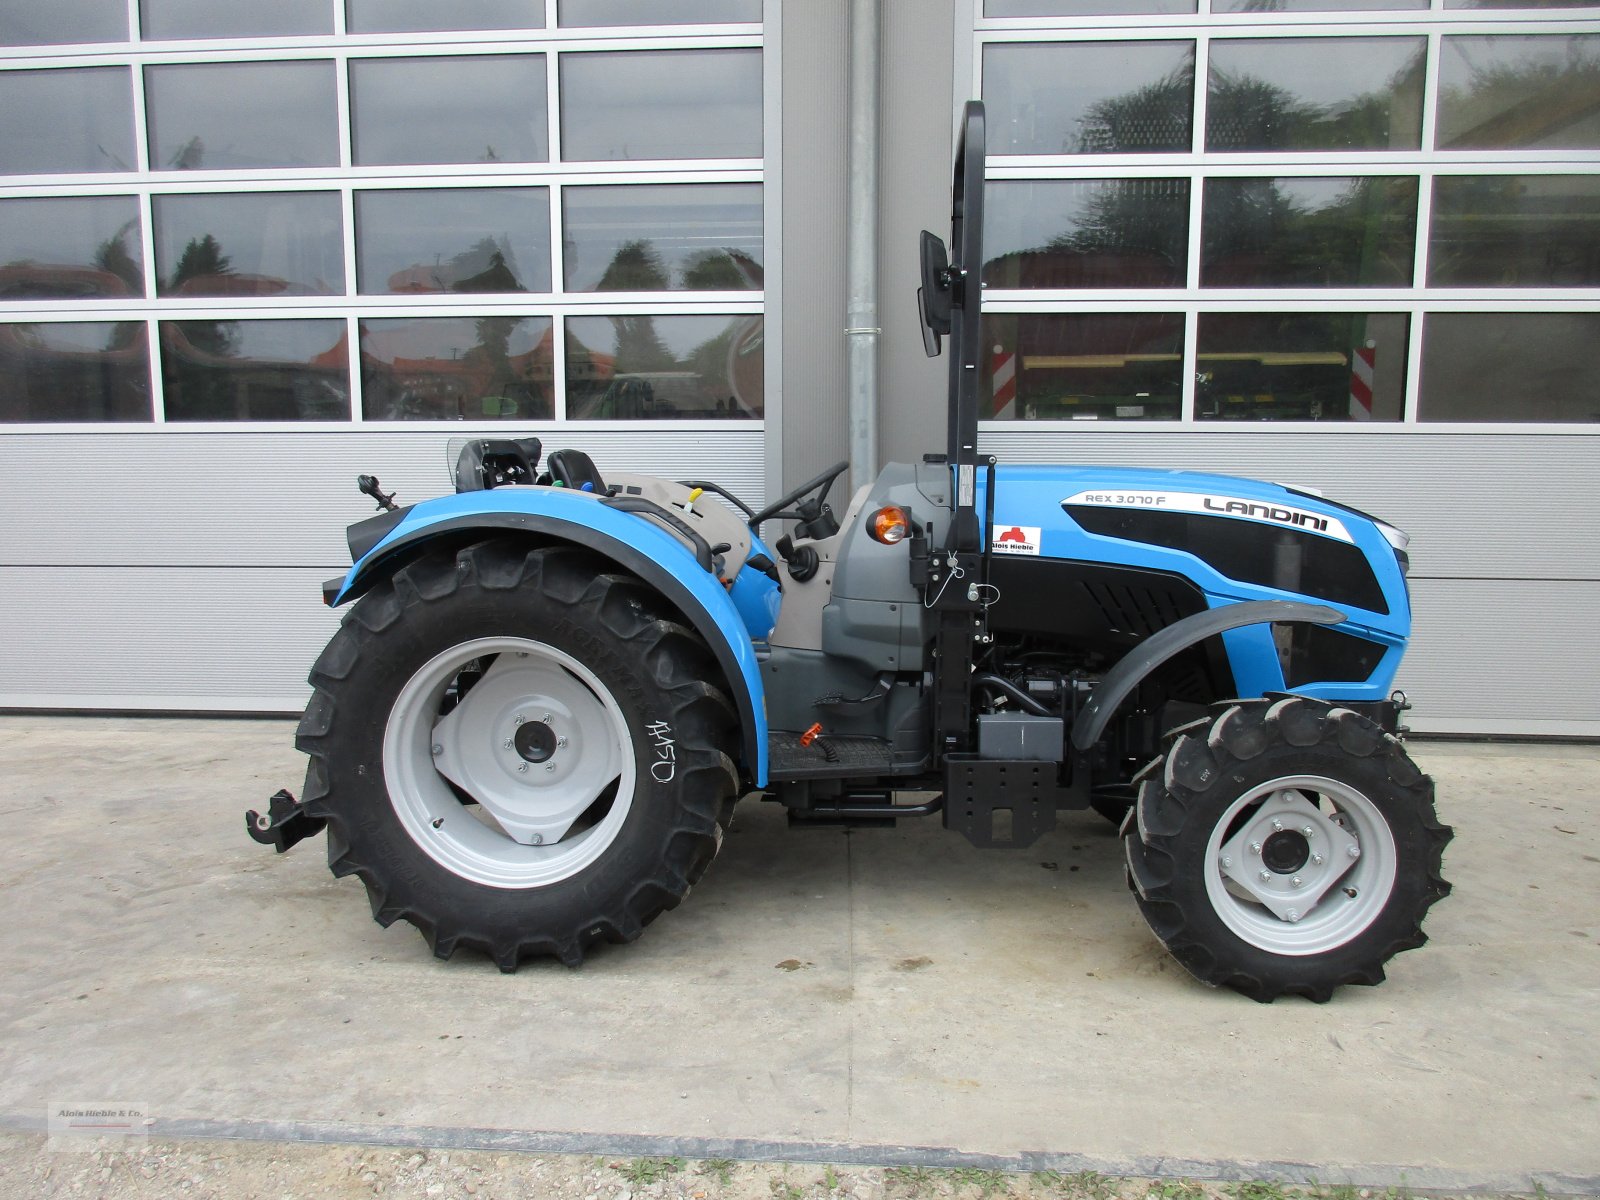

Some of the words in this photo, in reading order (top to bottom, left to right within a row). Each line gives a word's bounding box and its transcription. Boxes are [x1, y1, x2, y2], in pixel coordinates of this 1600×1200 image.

[1085, 494, 1112, 503] REX
[1116, 495, 1153, 505] 3.070
[1156, 496, 1166, 506] F
[1203, 498, 1328, 532] LANDINI
